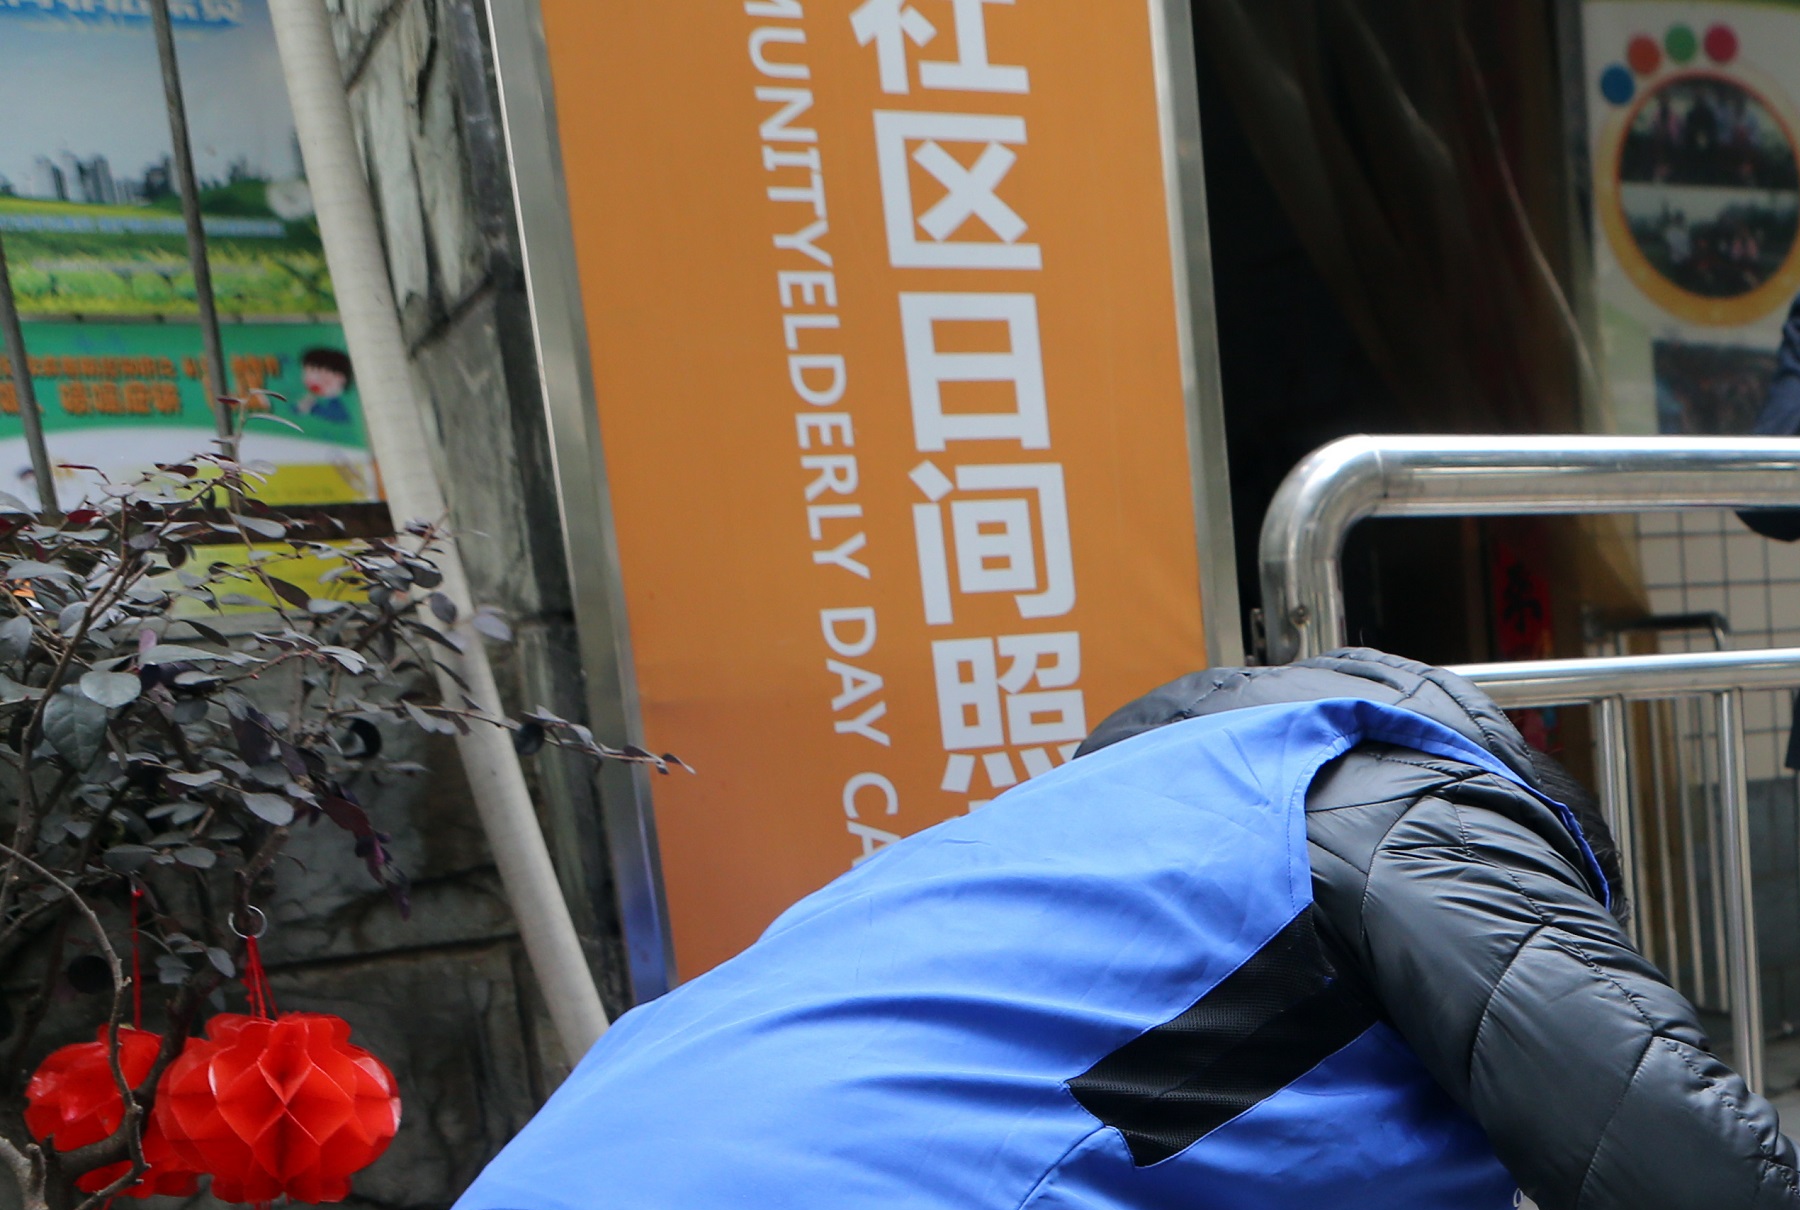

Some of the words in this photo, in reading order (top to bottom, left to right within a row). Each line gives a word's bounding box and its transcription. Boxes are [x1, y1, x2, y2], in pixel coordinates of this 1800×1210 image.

[850, 0, 1088, 820] 社区日间照
[820, 606, 891, 747] DAY
